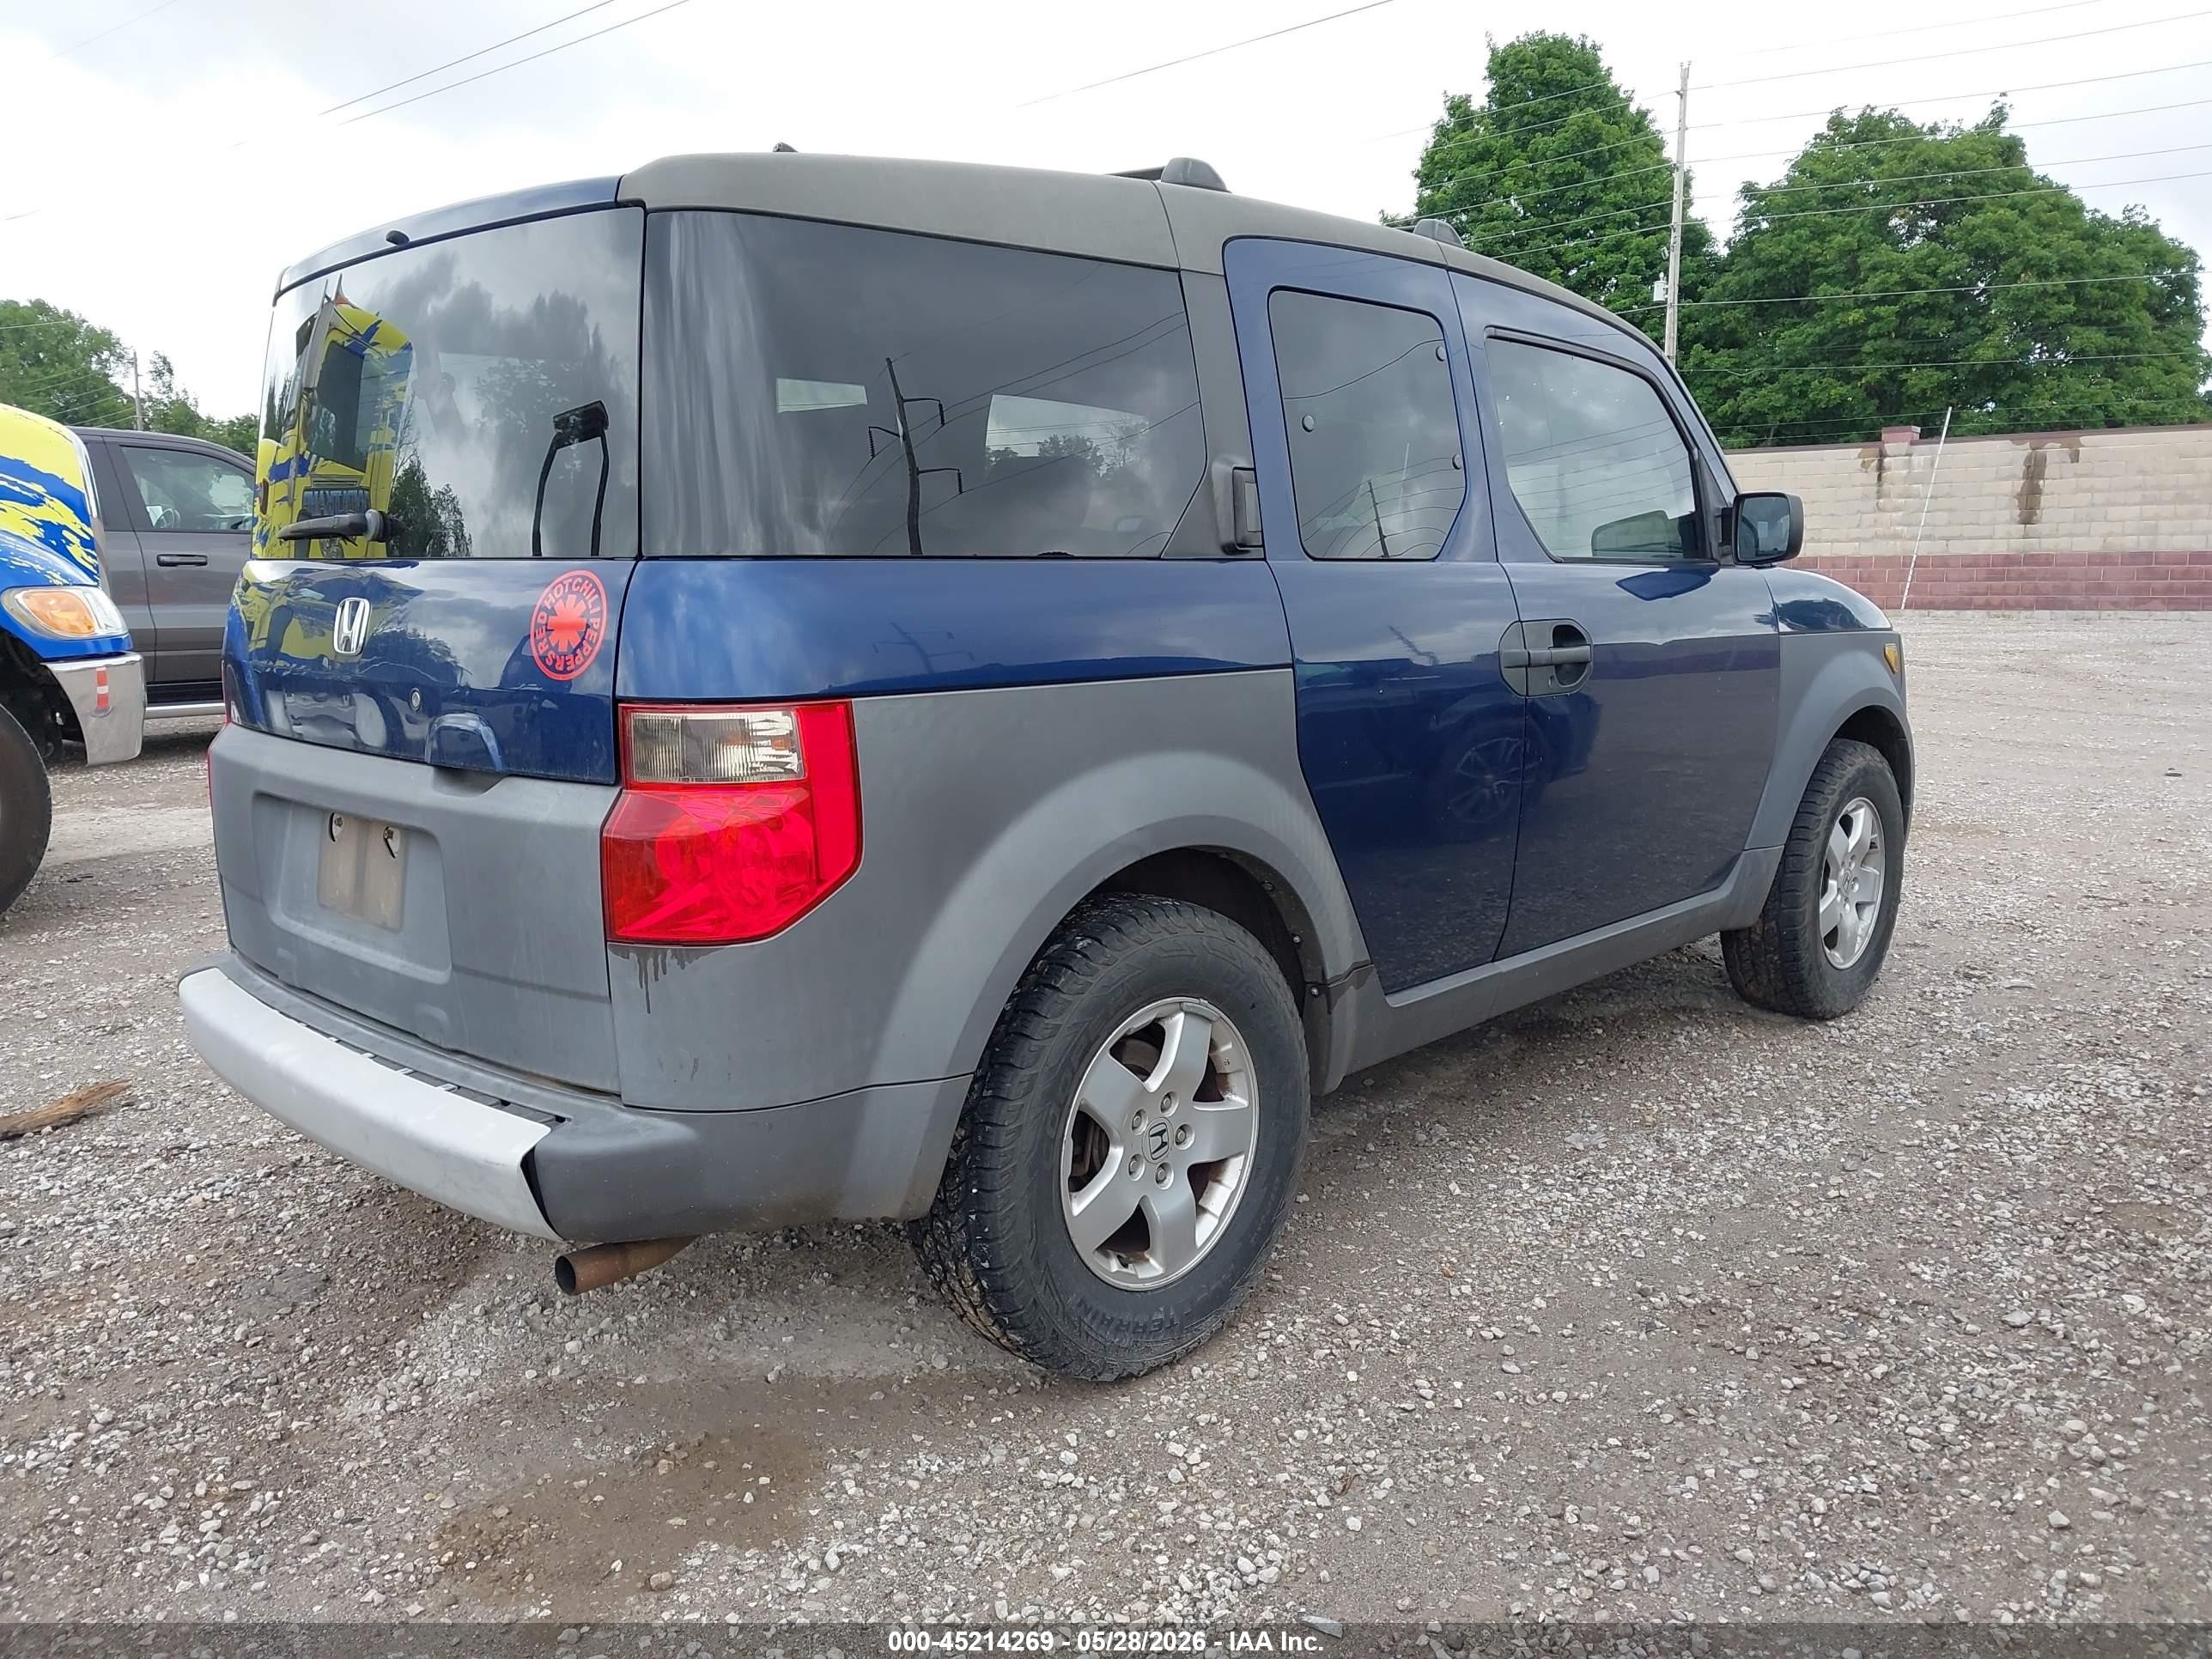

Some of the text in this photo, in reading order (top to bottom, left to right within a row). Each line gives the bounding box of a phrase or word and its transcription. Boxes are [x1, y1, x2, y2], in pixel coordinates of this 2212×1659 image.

[536, 577, 601, 672] RED HOT CHILI PEPPERS
